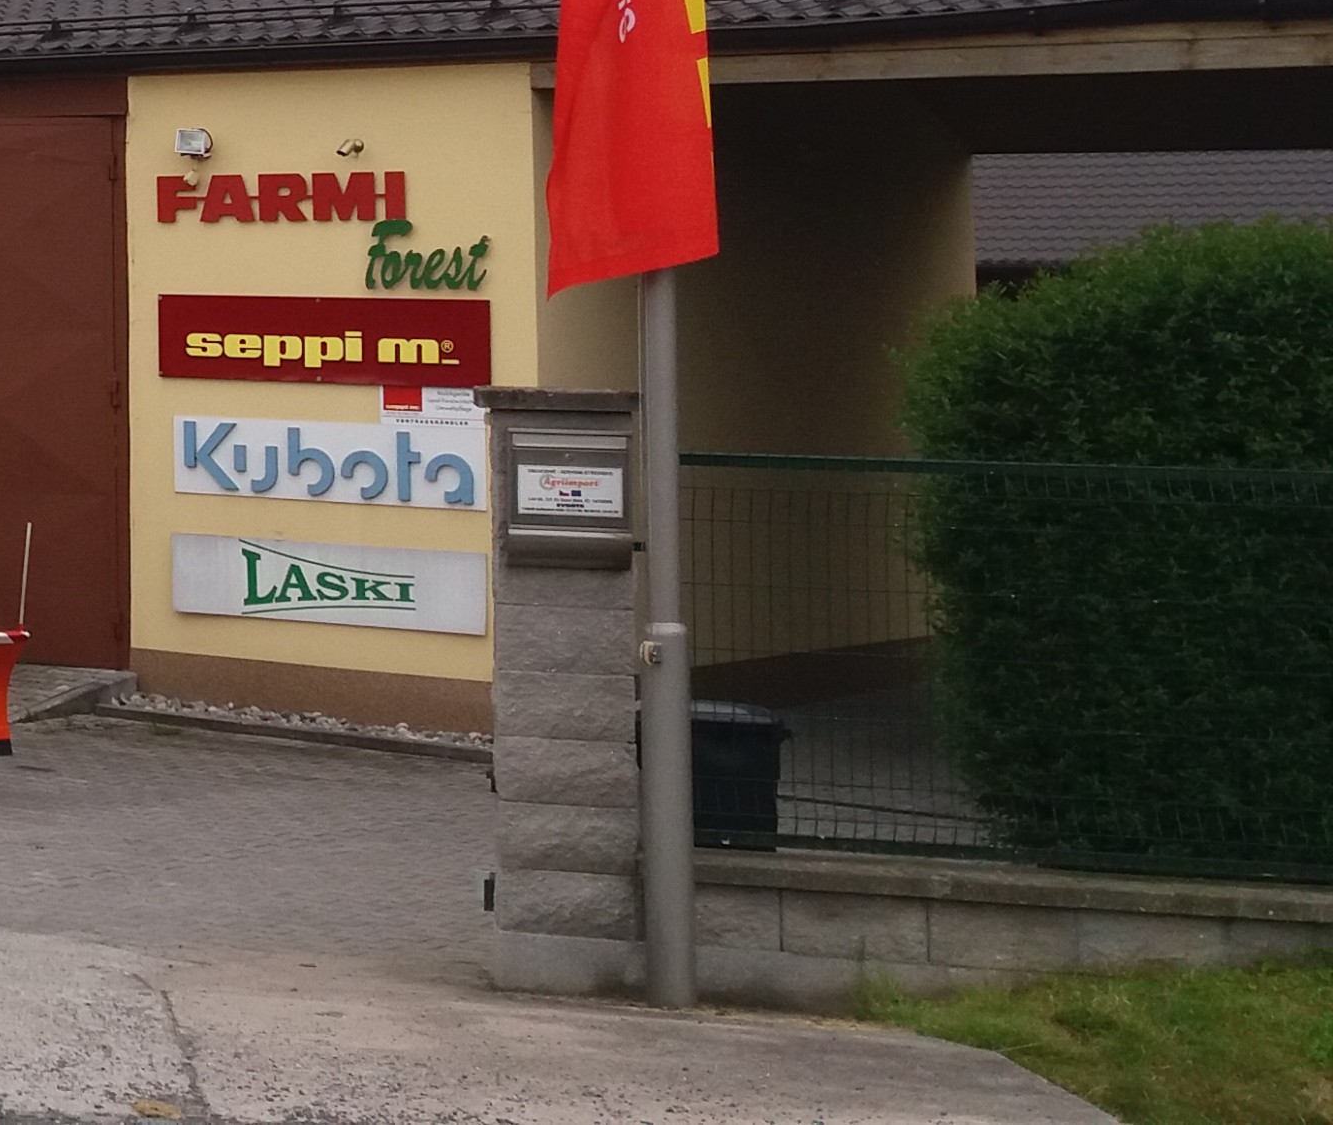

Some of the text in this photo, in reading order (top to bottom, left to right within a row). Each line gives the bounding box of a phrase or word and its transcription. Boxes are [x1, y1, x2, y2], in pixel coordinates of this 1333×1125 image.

[156, 171, 407, 223] FARMI
[365, 219, 491, 290] Forest
[185, 331, 363, 368] seppi
[182, 421, 475, 505] Kubota
[544, 477, 600, 488] Agriimport
[240, 548, 416, 607] LASKI
